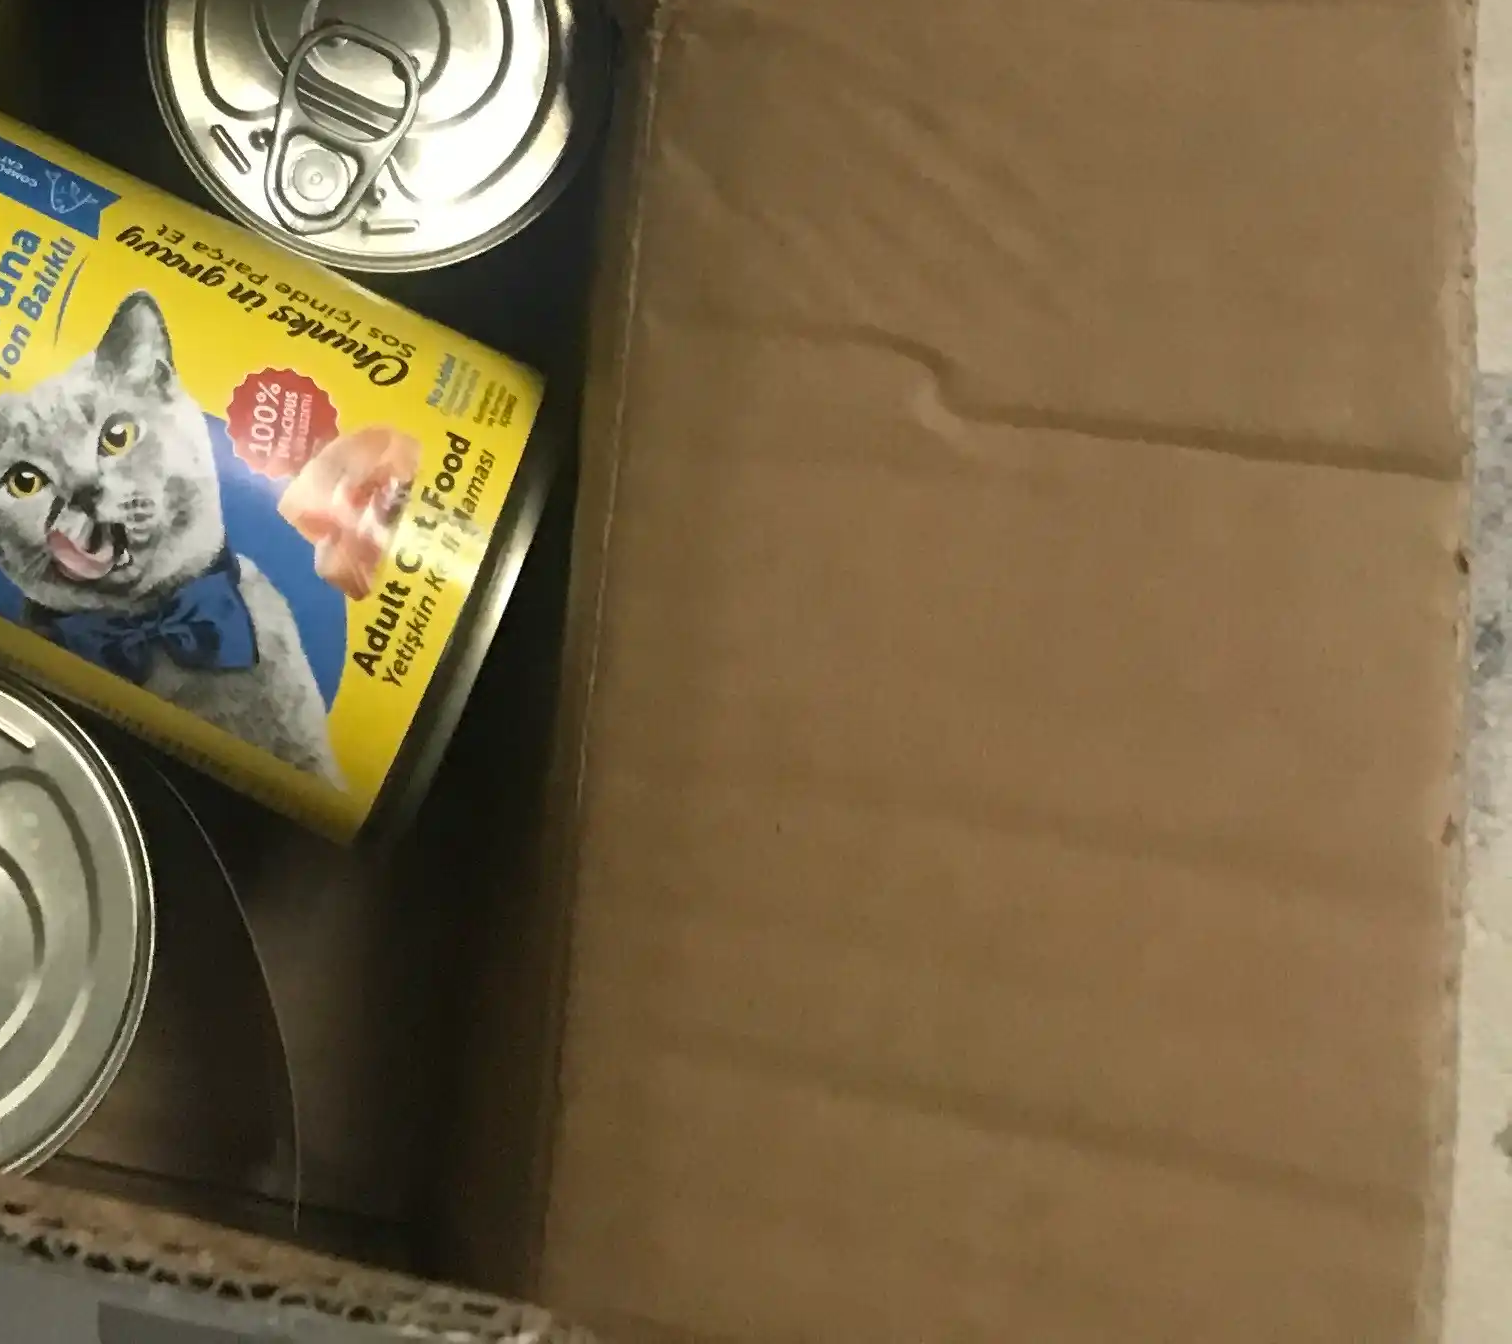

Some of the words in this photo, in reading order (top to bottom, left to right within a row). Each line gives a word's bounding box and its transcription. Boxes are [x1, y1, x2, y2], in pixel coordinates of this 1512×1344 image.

[0, 154, 24, 170] CAT
[116, 223, 228, 288] gravy
[154, 222, 185, 245] Et
[190, 239, 269, 287] Parça
[226, 280, 268, 317] in
[265, 303, 410, 389] Chunks
[366, 326, 416, 359] Sos
[247, 378, 281, 455] 100%
[348, 575, 411, 675] Adult
[418, 430, 472, 511] Food
[381, 592, 437, 688] Yetişkin
